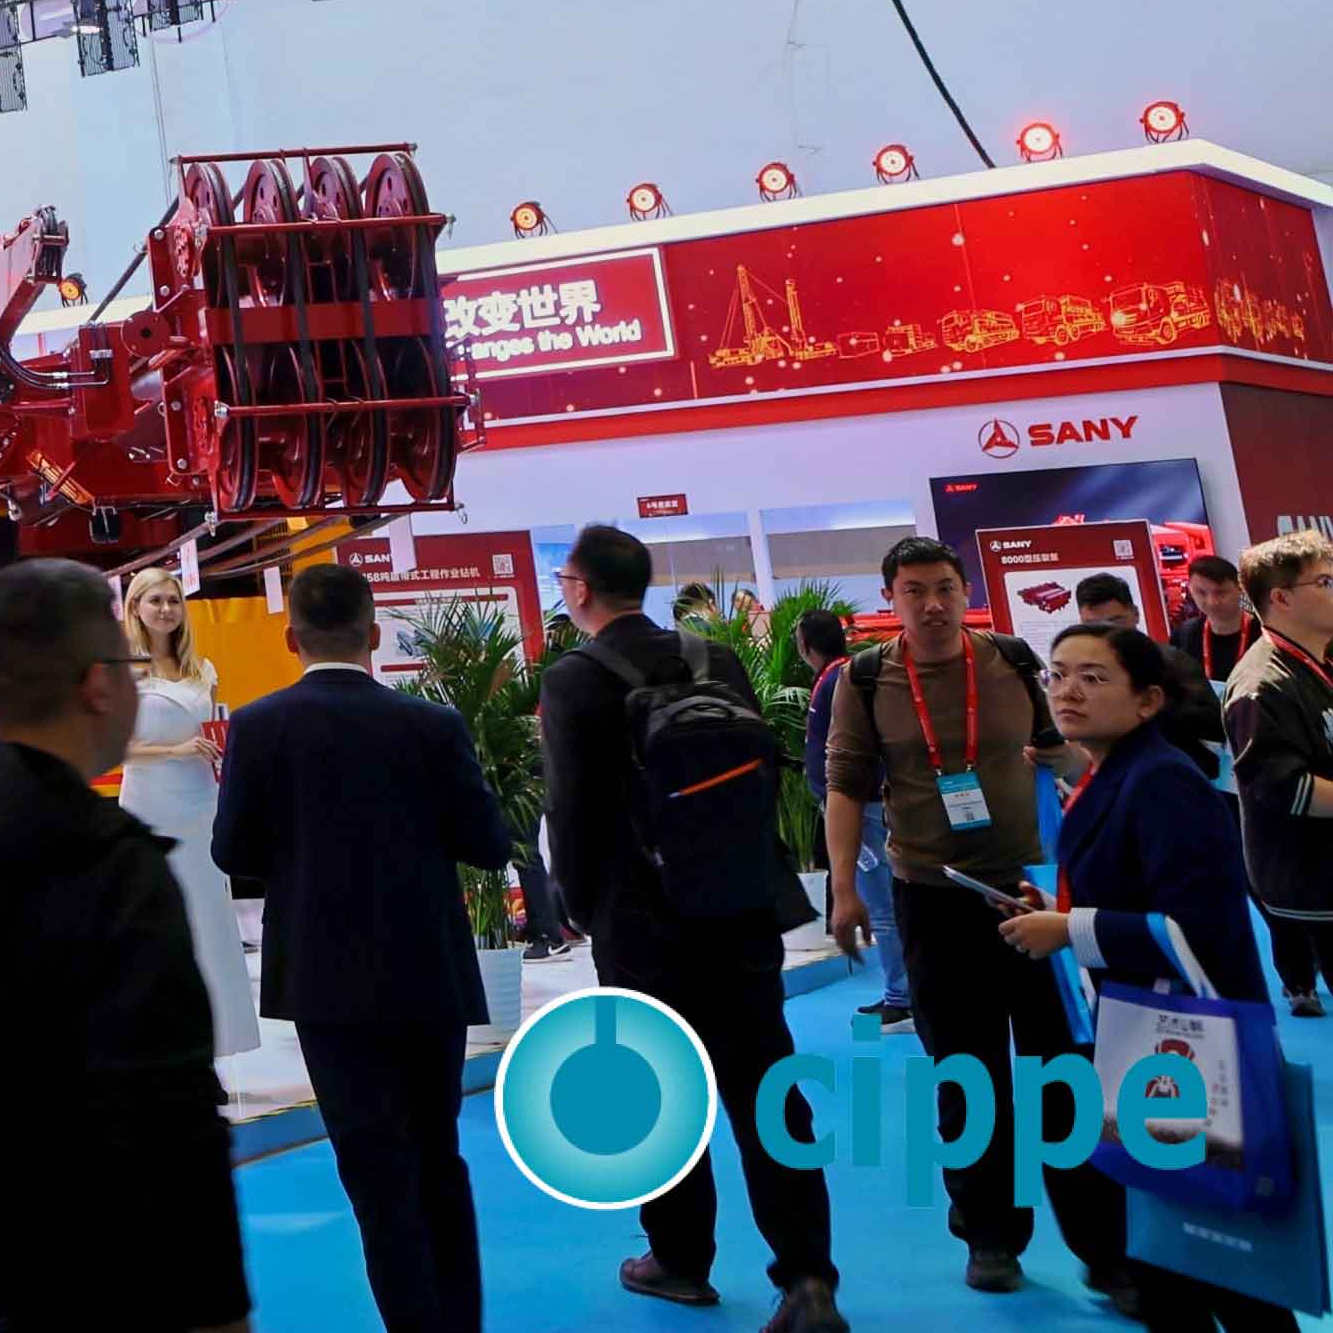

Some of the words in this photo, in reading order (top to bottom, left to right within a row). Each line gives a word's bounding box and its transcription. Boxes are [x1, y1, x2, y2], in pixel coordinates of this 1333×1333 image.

[537, 329, 573, 352] the
[575, 318, 642, 347] World
[1028, 415, 1139, 446] SANY
[1002, 540, 1032, 549] SANY
[364, 554, 393, 564] SAN
